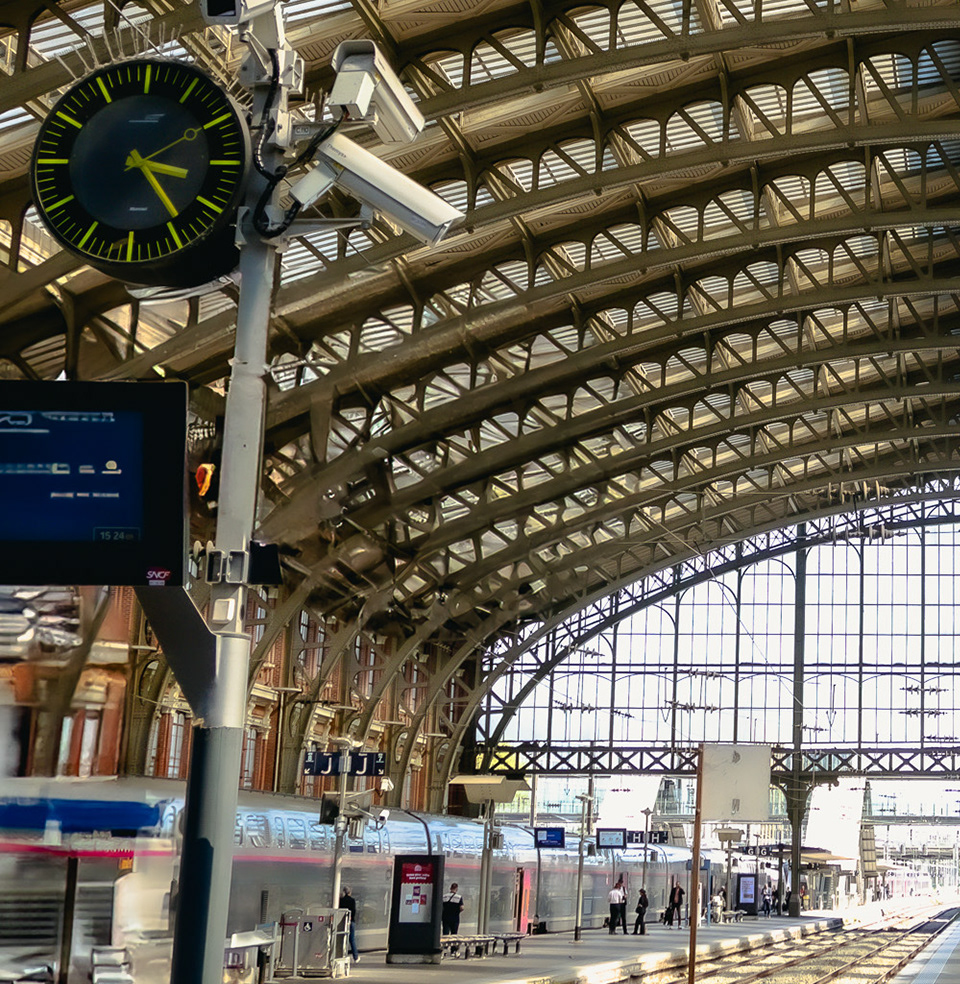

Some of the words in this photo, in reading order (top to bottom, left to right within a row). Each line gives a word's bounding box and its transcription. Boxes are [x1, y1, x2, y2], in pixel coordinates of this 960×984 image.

[100, 531, 111, 540] 15
[146, 570, 170, 579] SNCF
[320, 757, 332, 774] J
[355, 757, 367, 775] J
[633, 833, 641, 843] H
[651, 833, 660, 843] H
[747, 848, 754, 856] G
[760, 848, 767, 856] G
